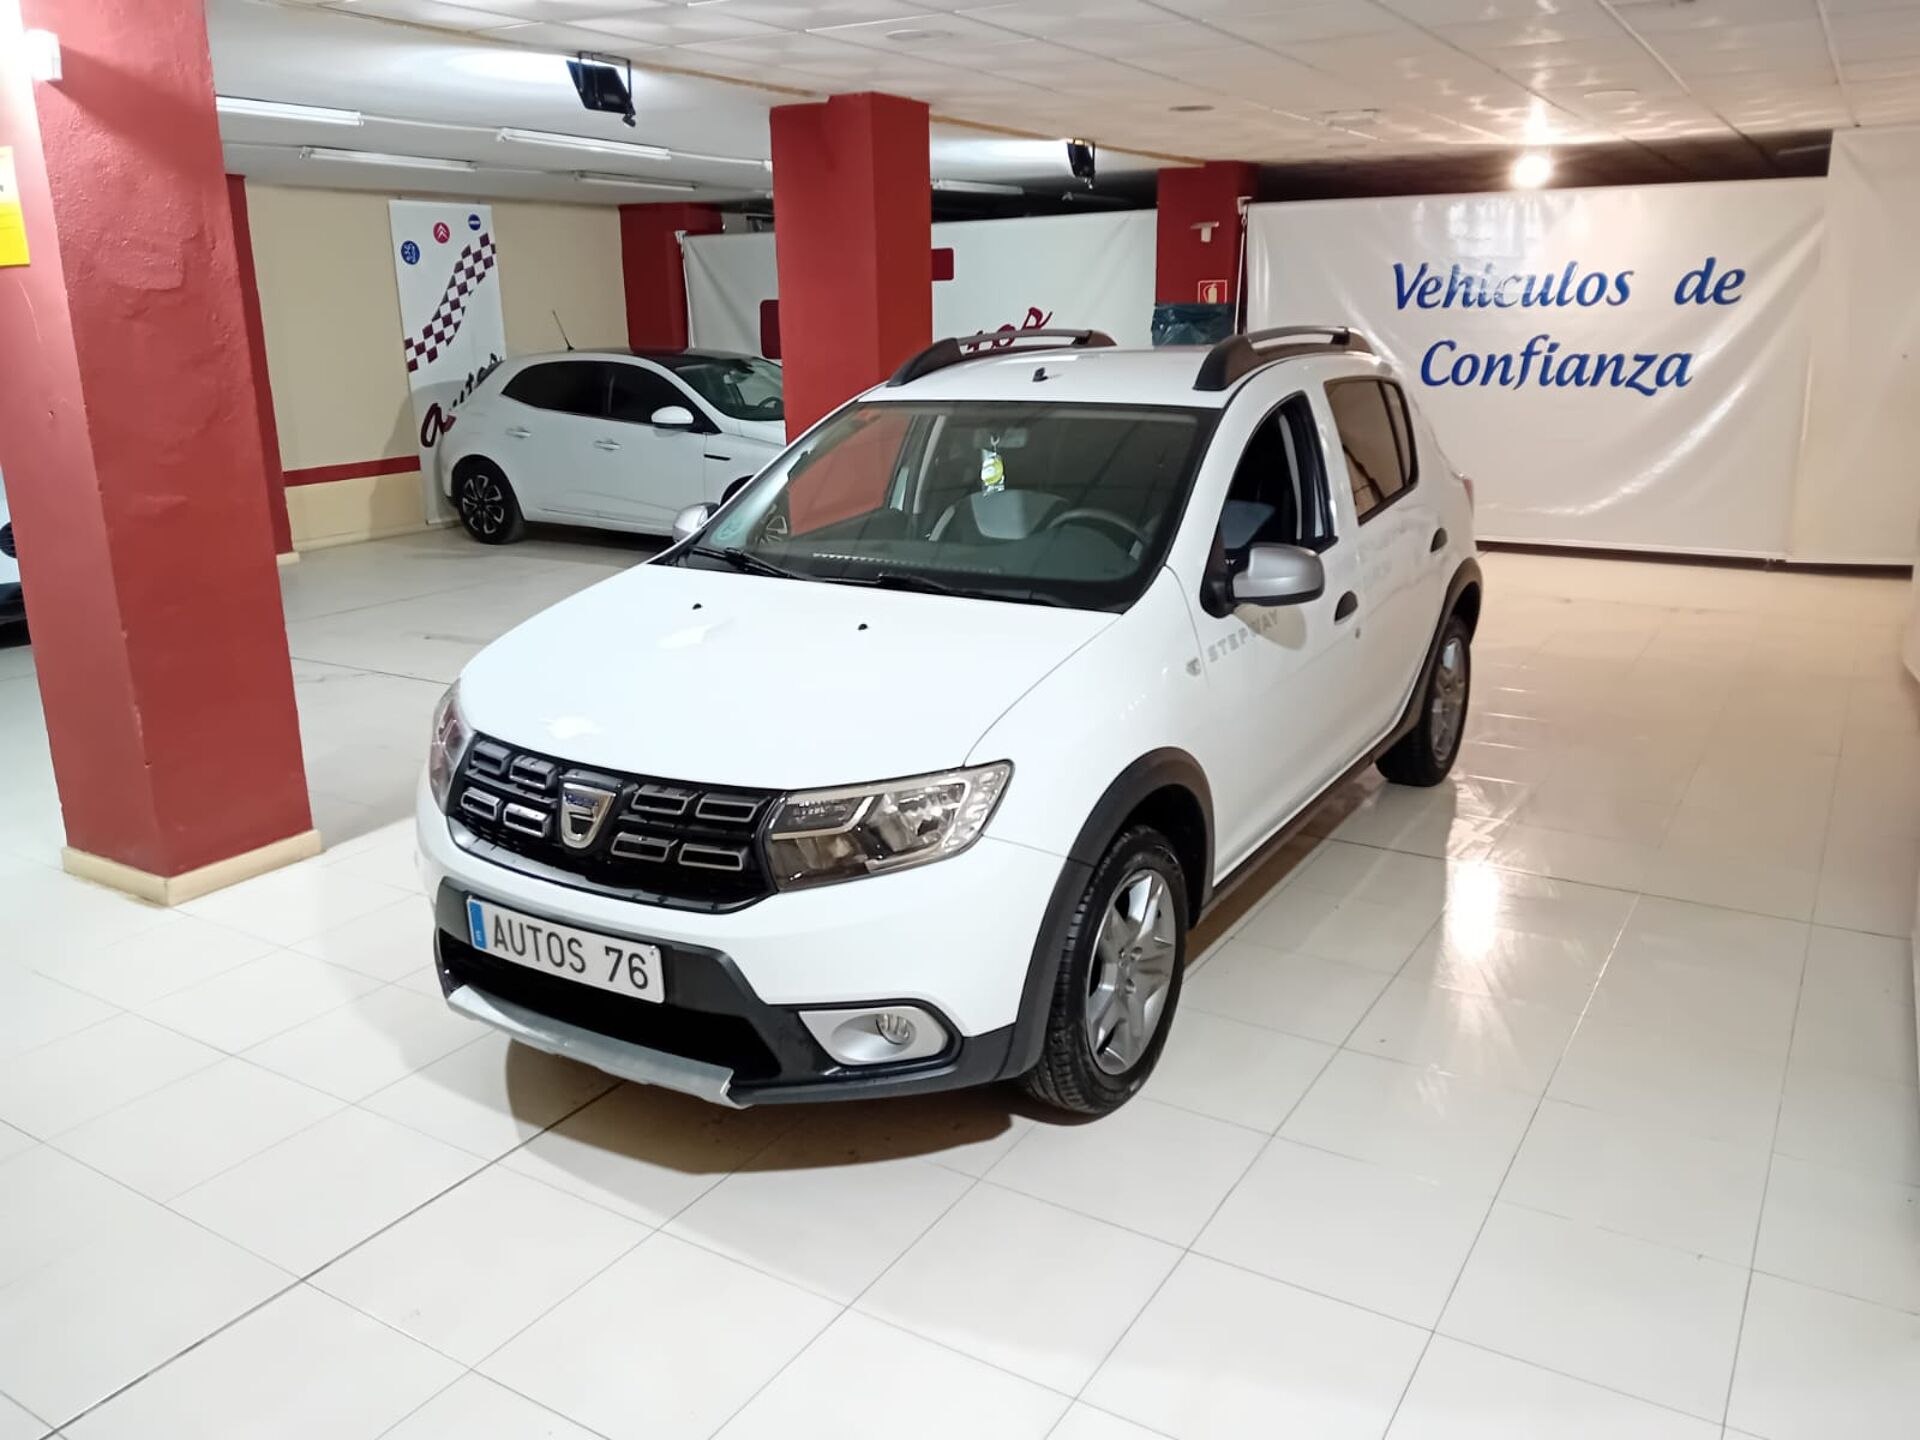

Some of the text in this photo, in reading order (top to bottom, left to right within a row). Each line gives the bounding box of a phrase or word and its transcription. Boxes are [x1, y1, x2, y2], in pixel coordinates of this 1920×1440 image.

[1674, 257, 1746, 305] de
[1420, 334, 1694, 397] Confianza
[1207, 609, 1278, 662] STEPWAY
[494, 914, 648, 990] AUTOS 76
